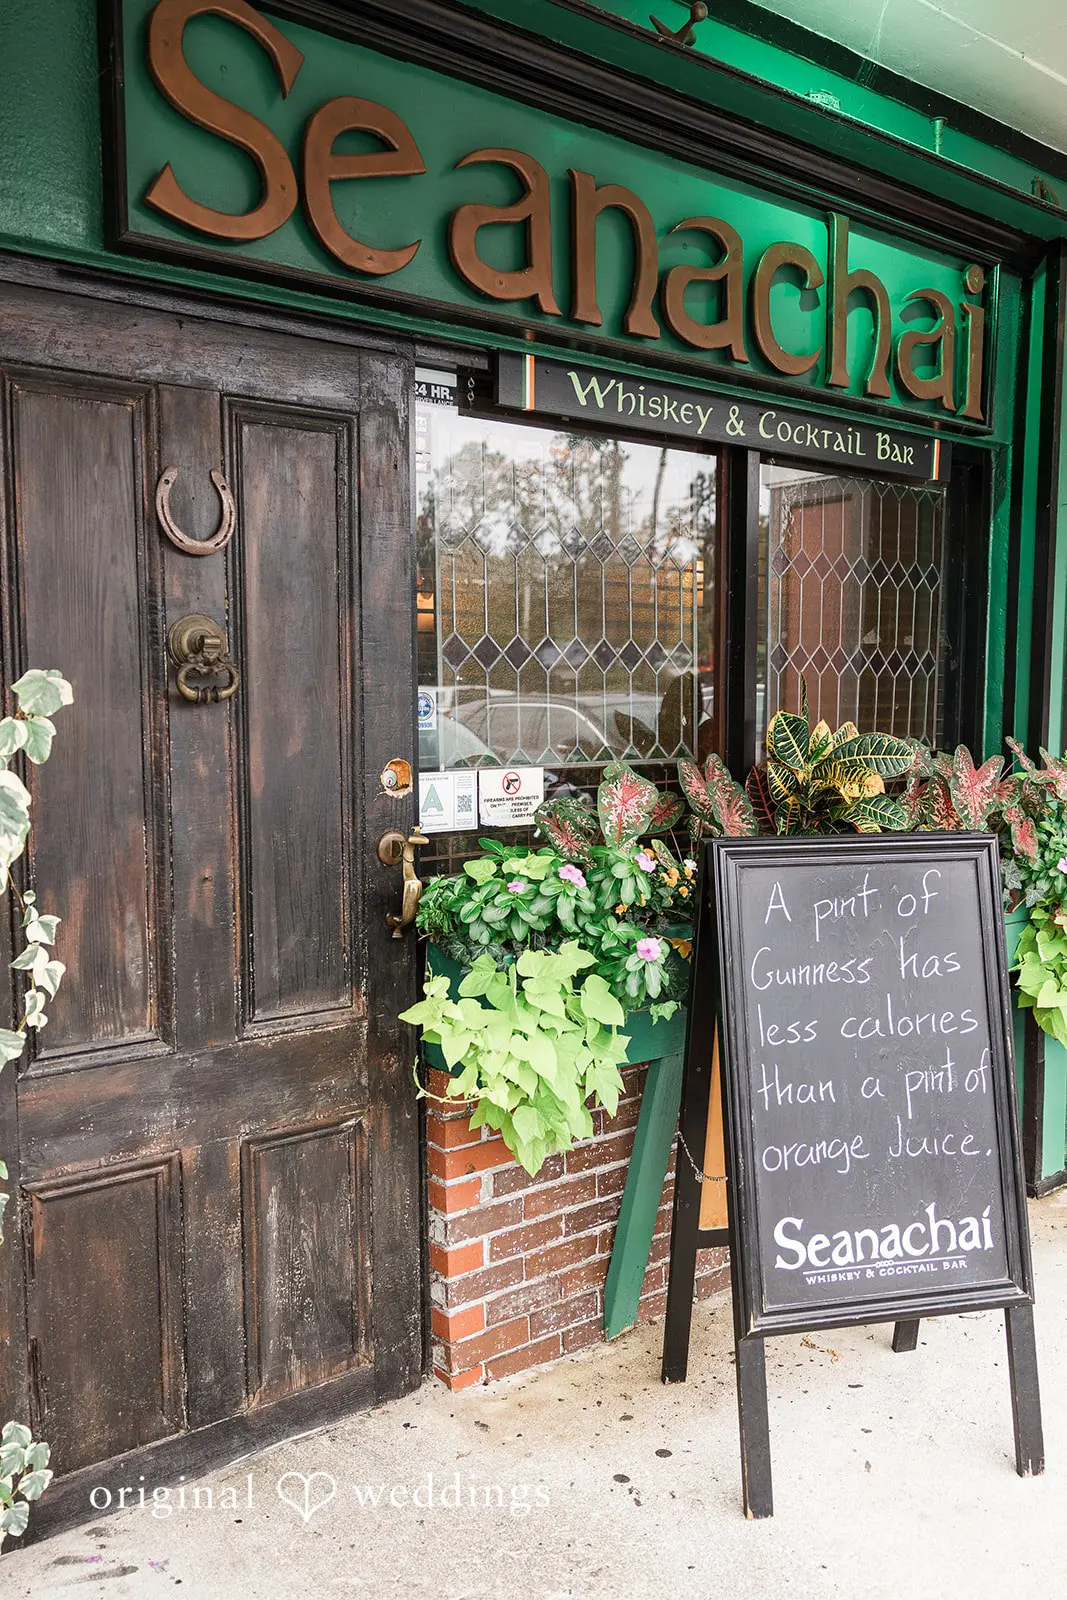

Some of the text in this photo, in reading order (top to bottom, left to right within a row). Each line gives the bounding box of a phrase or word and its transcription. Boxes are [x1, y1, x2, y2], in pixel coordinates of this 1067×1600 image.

[145, 0, 986, 421] Seanachai
[431, 385, 454, 400] HR.
[566, 371, 915, 466] Whiskey & Cocktail Bar
[421, 784, 444, 813] A
[765, 869, 942, 943] A pint of
[750, 936, 961, 991] Guinness has
[757, 993, 979, 1048] less calories
[757, 1046, 990, 1120] than a pint of
[762, 1135, 870, 1174] orange
[805, 1260, 968, 1286] WHISKEY & COCKTAIL BAR
